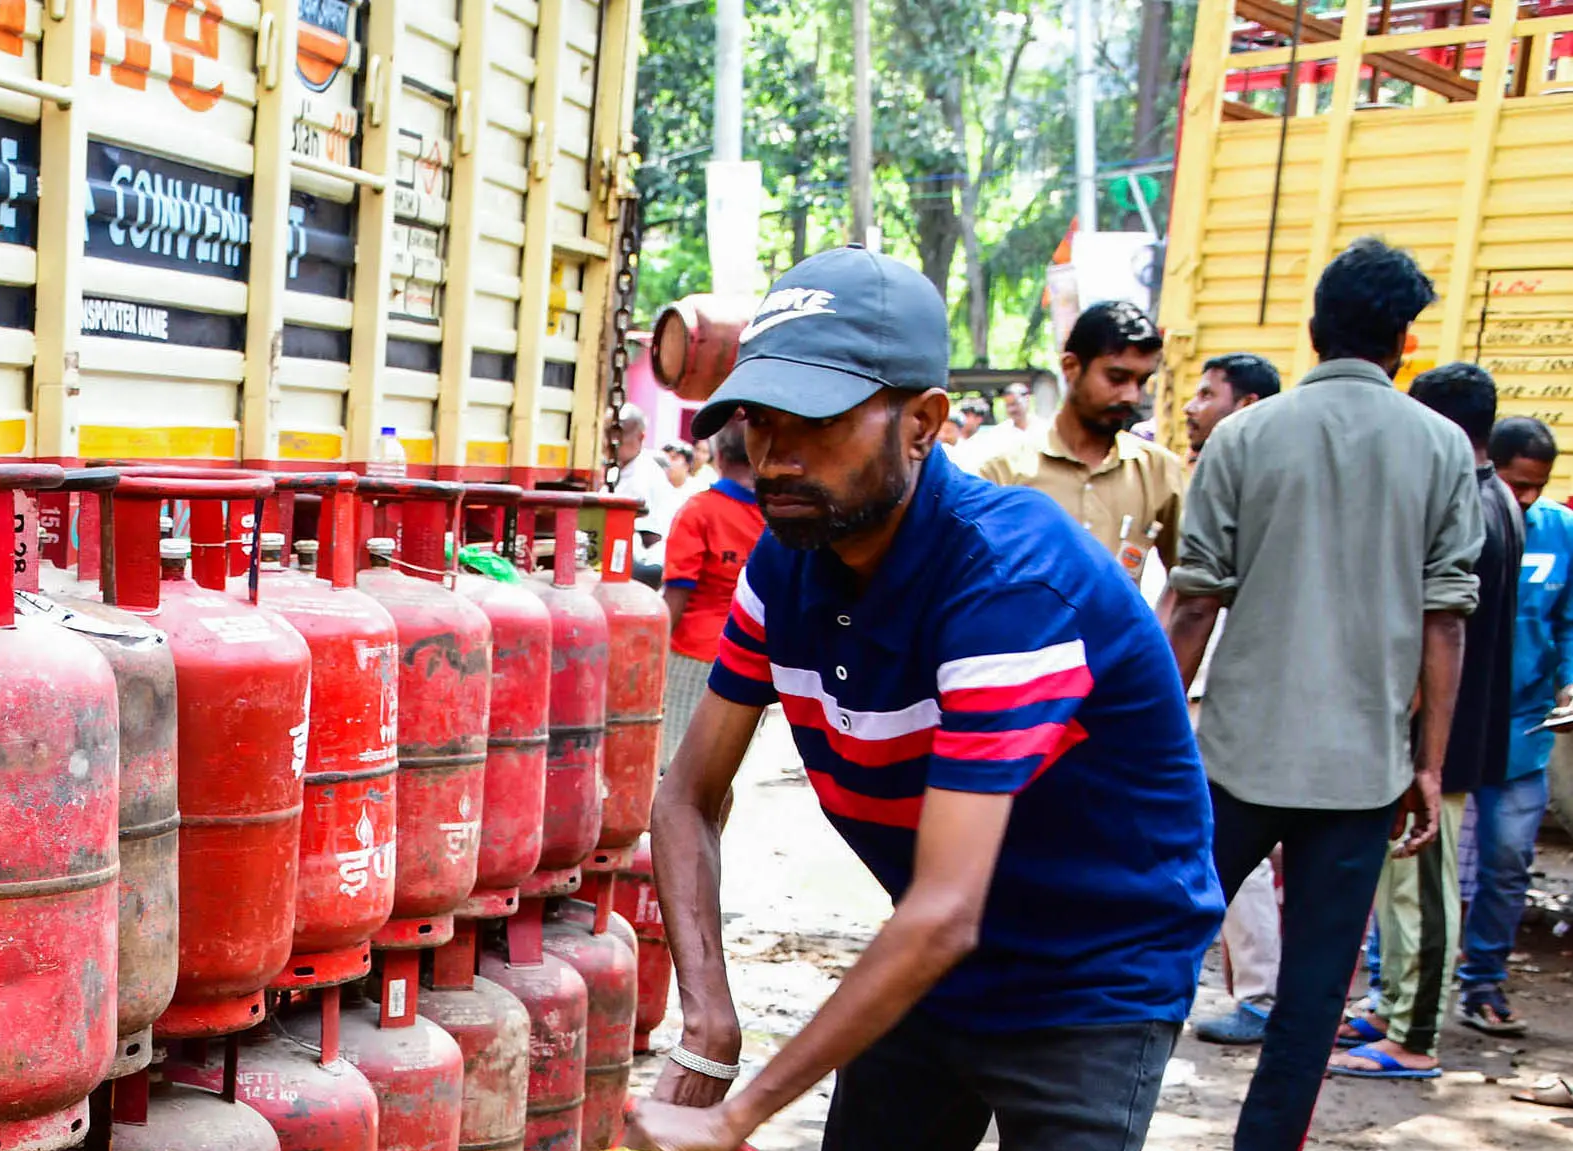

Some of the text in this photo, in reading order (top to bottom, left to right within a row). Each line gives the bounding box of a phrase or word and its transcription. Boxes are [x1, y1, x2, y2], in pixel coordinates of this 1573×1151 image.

[81, 299, 168, 340] NSPORTER NAME
[1520, 552, 1557, 584] 7
